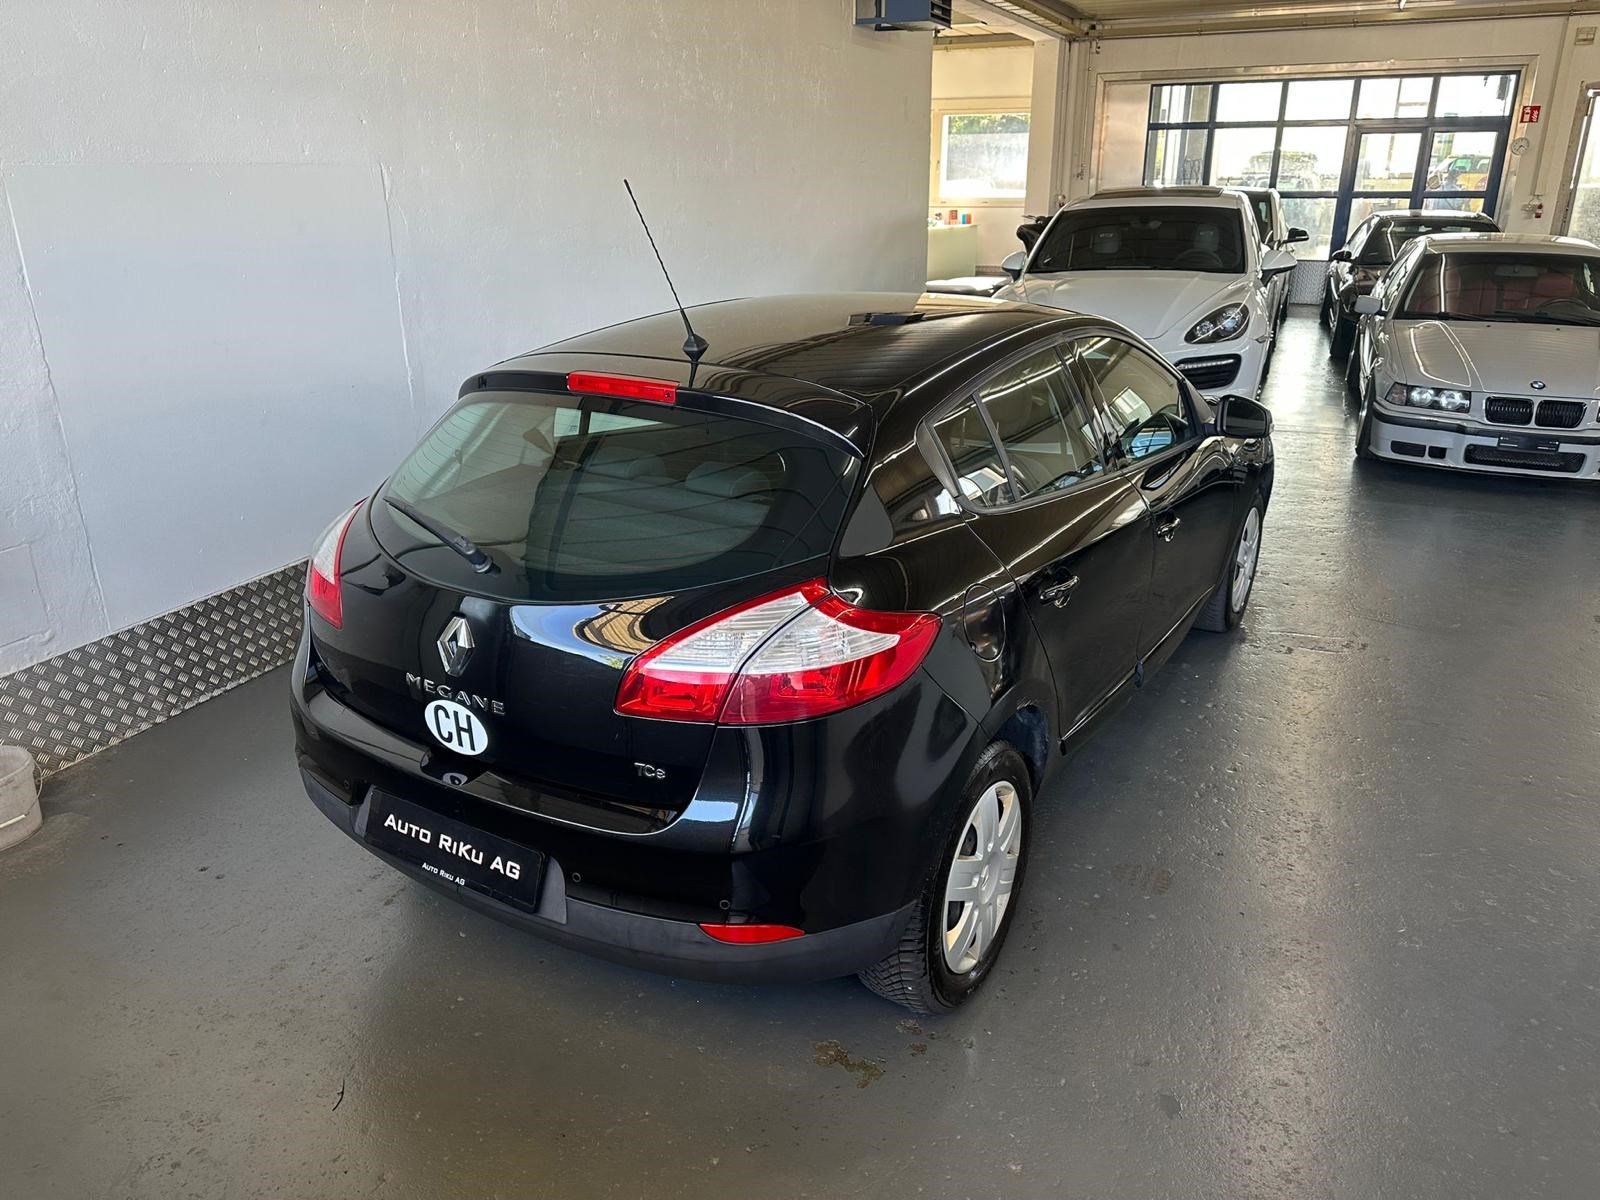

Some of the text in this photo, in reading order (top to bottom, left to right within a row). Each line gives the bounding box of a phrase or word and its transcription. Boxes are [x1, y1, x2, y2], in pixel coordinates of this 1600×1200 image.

[405, 672, 506, 716] MEGANE
[433, 704, 476, 752] CH
[455, 876, 466, 886] AG
[489, 856, 521, 880] AG
